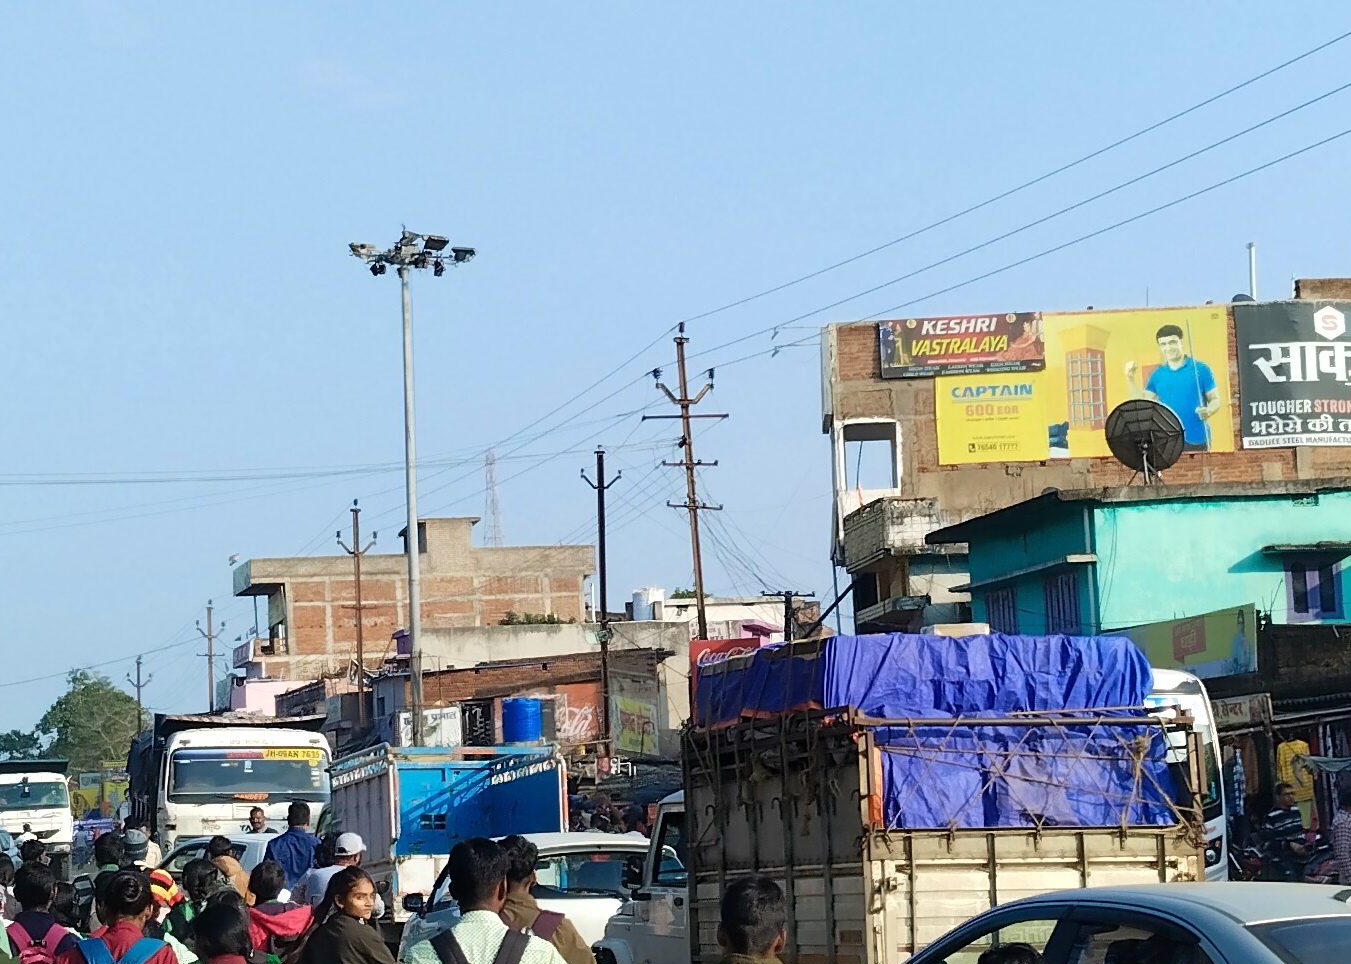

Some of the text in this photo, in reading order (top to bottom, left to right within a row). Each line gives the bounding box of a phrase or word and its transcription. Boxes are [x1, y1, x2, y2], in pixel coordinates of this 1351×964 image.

[921, 317, 997, 335] KESHRI
[911, 335, 1008, 356] VASTRALAYA
[952, 384, 1032, 398] CAPTAIN
[1250, 401, 1312, 415] TOUGHER
[1251, 415, 1303, 435] भरोसे
[1308, 413, 1333, 432] की
